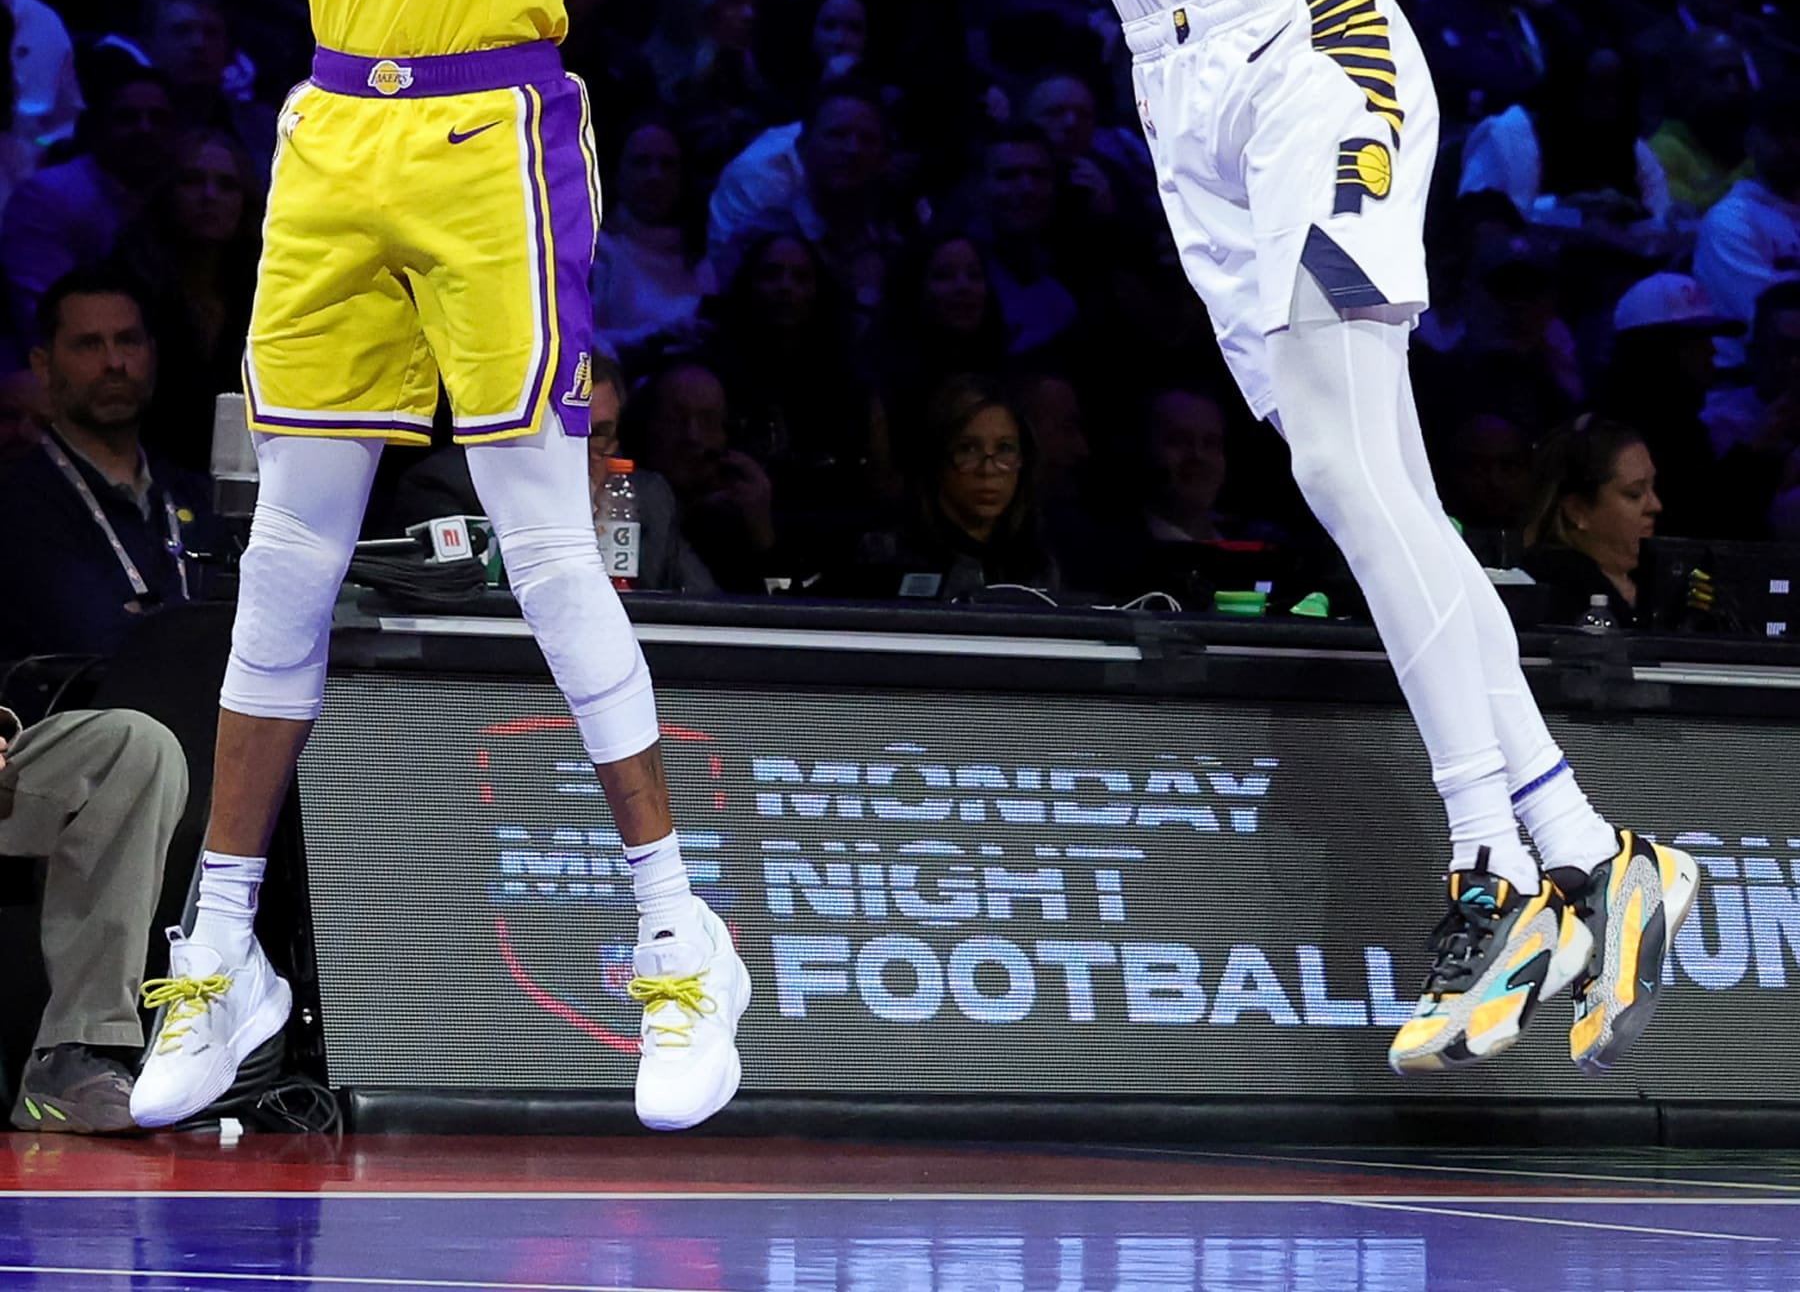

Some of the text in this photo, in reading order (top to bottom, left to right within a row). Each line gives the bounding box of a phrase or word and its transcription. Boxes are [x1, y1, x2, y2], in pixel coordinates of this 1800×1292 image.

[614, 552, 629, 571] 2
[752, 743, 1280, 834] MONDAY
[761, 839, 1147, 926] NIGHT
[771, 934, 1417, 1026] FOOTBALL
